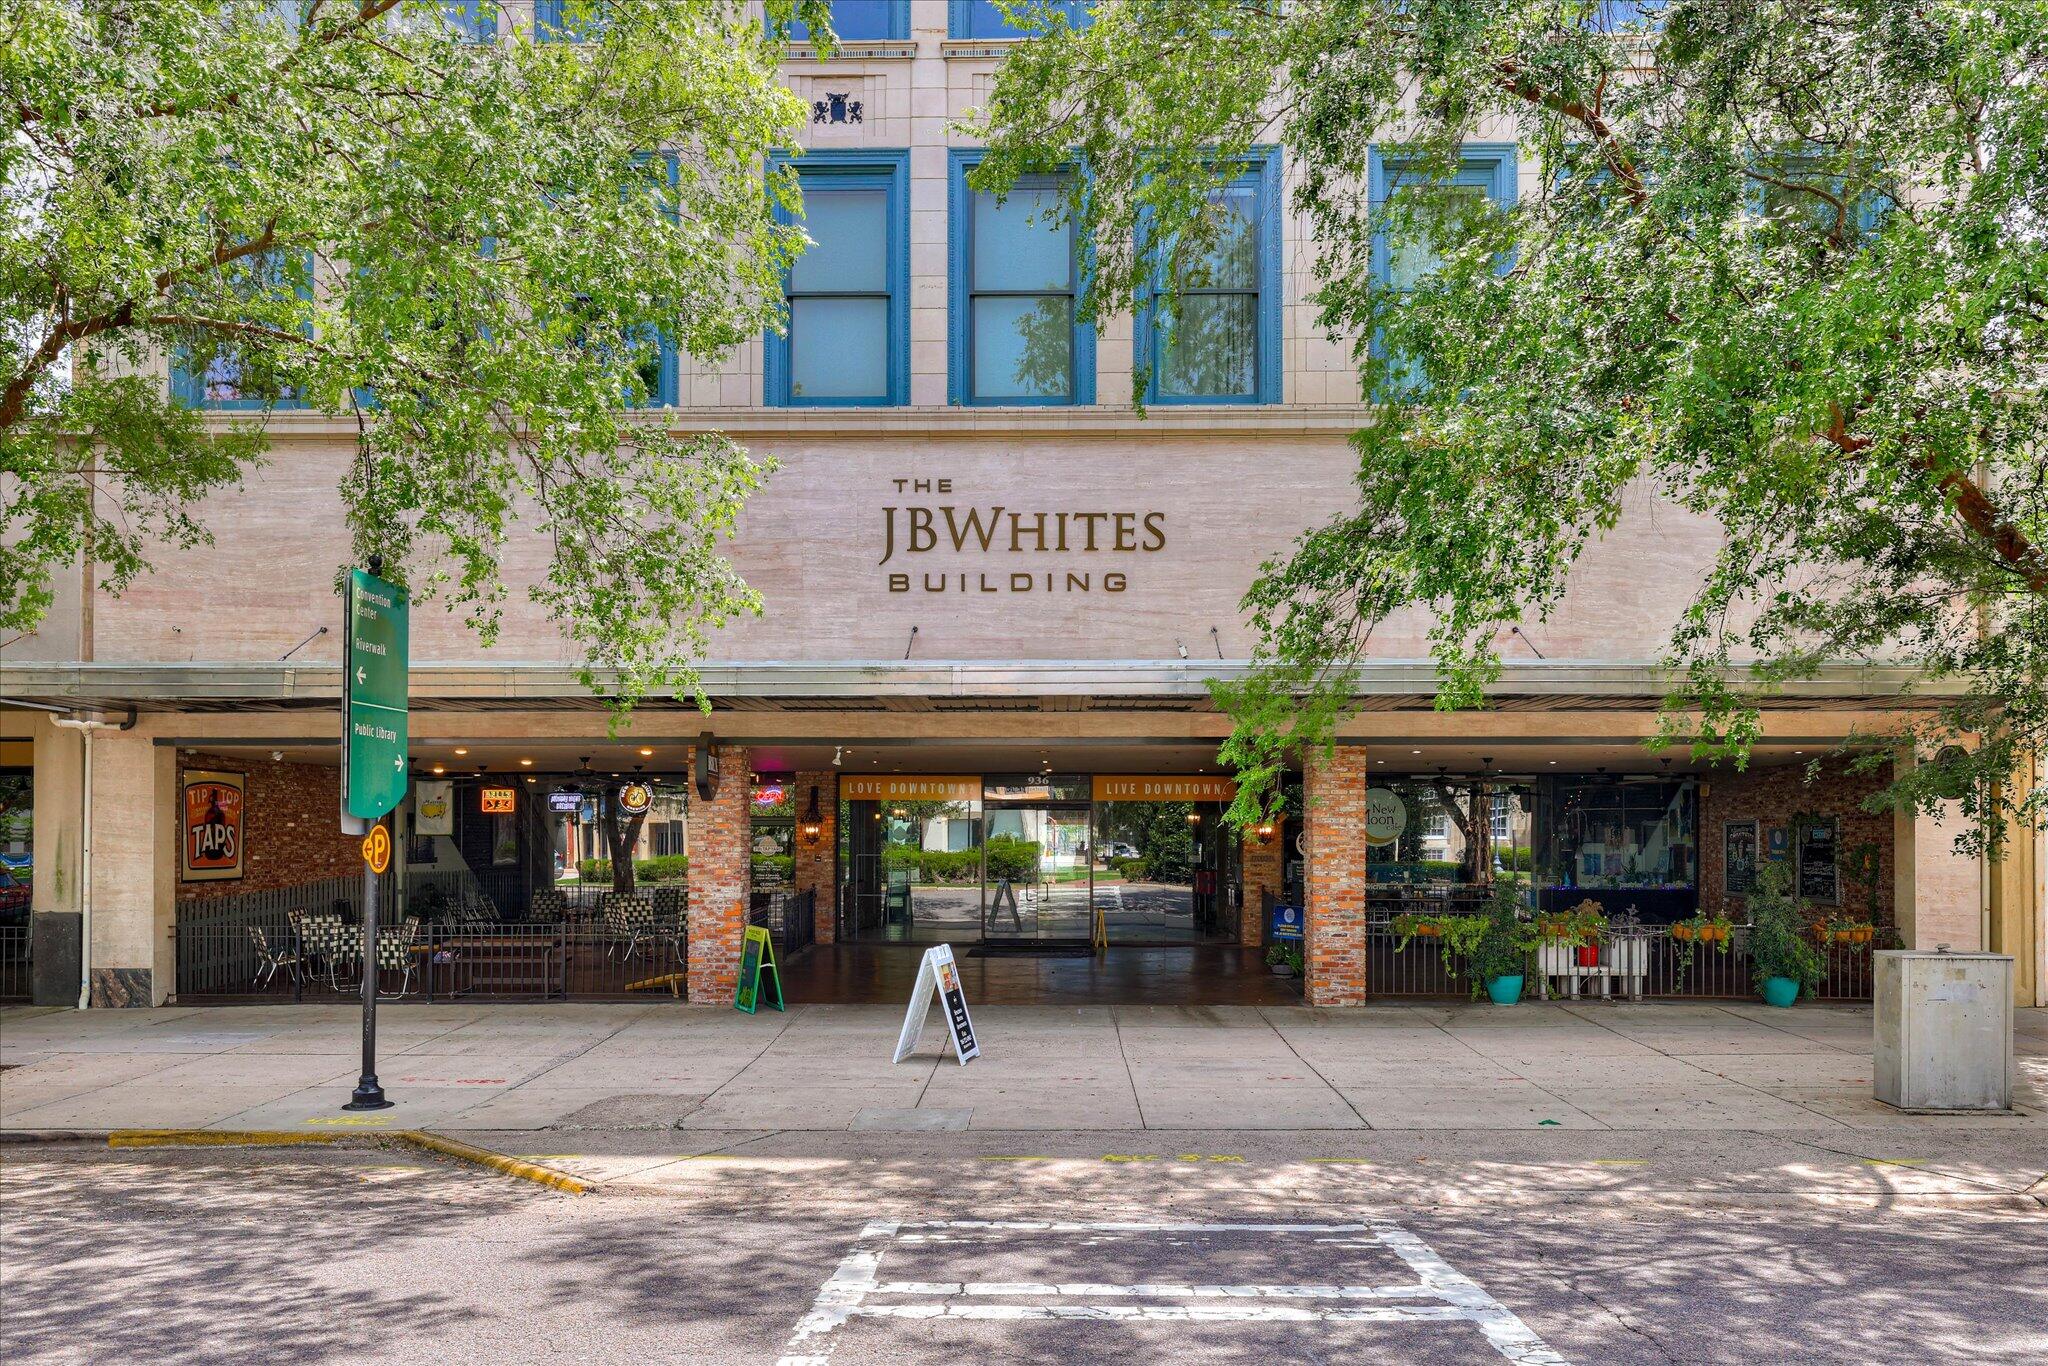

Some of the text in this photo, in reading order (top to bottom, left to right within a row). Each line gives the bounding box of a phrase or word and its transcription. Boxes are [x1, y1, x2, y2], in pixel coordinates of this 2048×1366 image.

[893, 479, 952, 493] THE
[889, 573, 1127, 592] BUILDING
[356, 587, 391, 608] Convention
[356, 603, 377, 620] Center
[355, 637, 387, 656] Riverwalk
[355, 723, 397, 743] Public Library
[850, 783, 977, 794] LOVE DOWNTOWN?
[1027, 776, 1050, 785] 936
[1106, 783, 1137, 795] LIVE
[189, 789, 239, 806] TIP TOP
[755, 791, 784, 801] OPEN
[1372, 804, 1396, 814] New
[192, 823, 236, 858] TAPS
[374, 834, 386, 865] P
